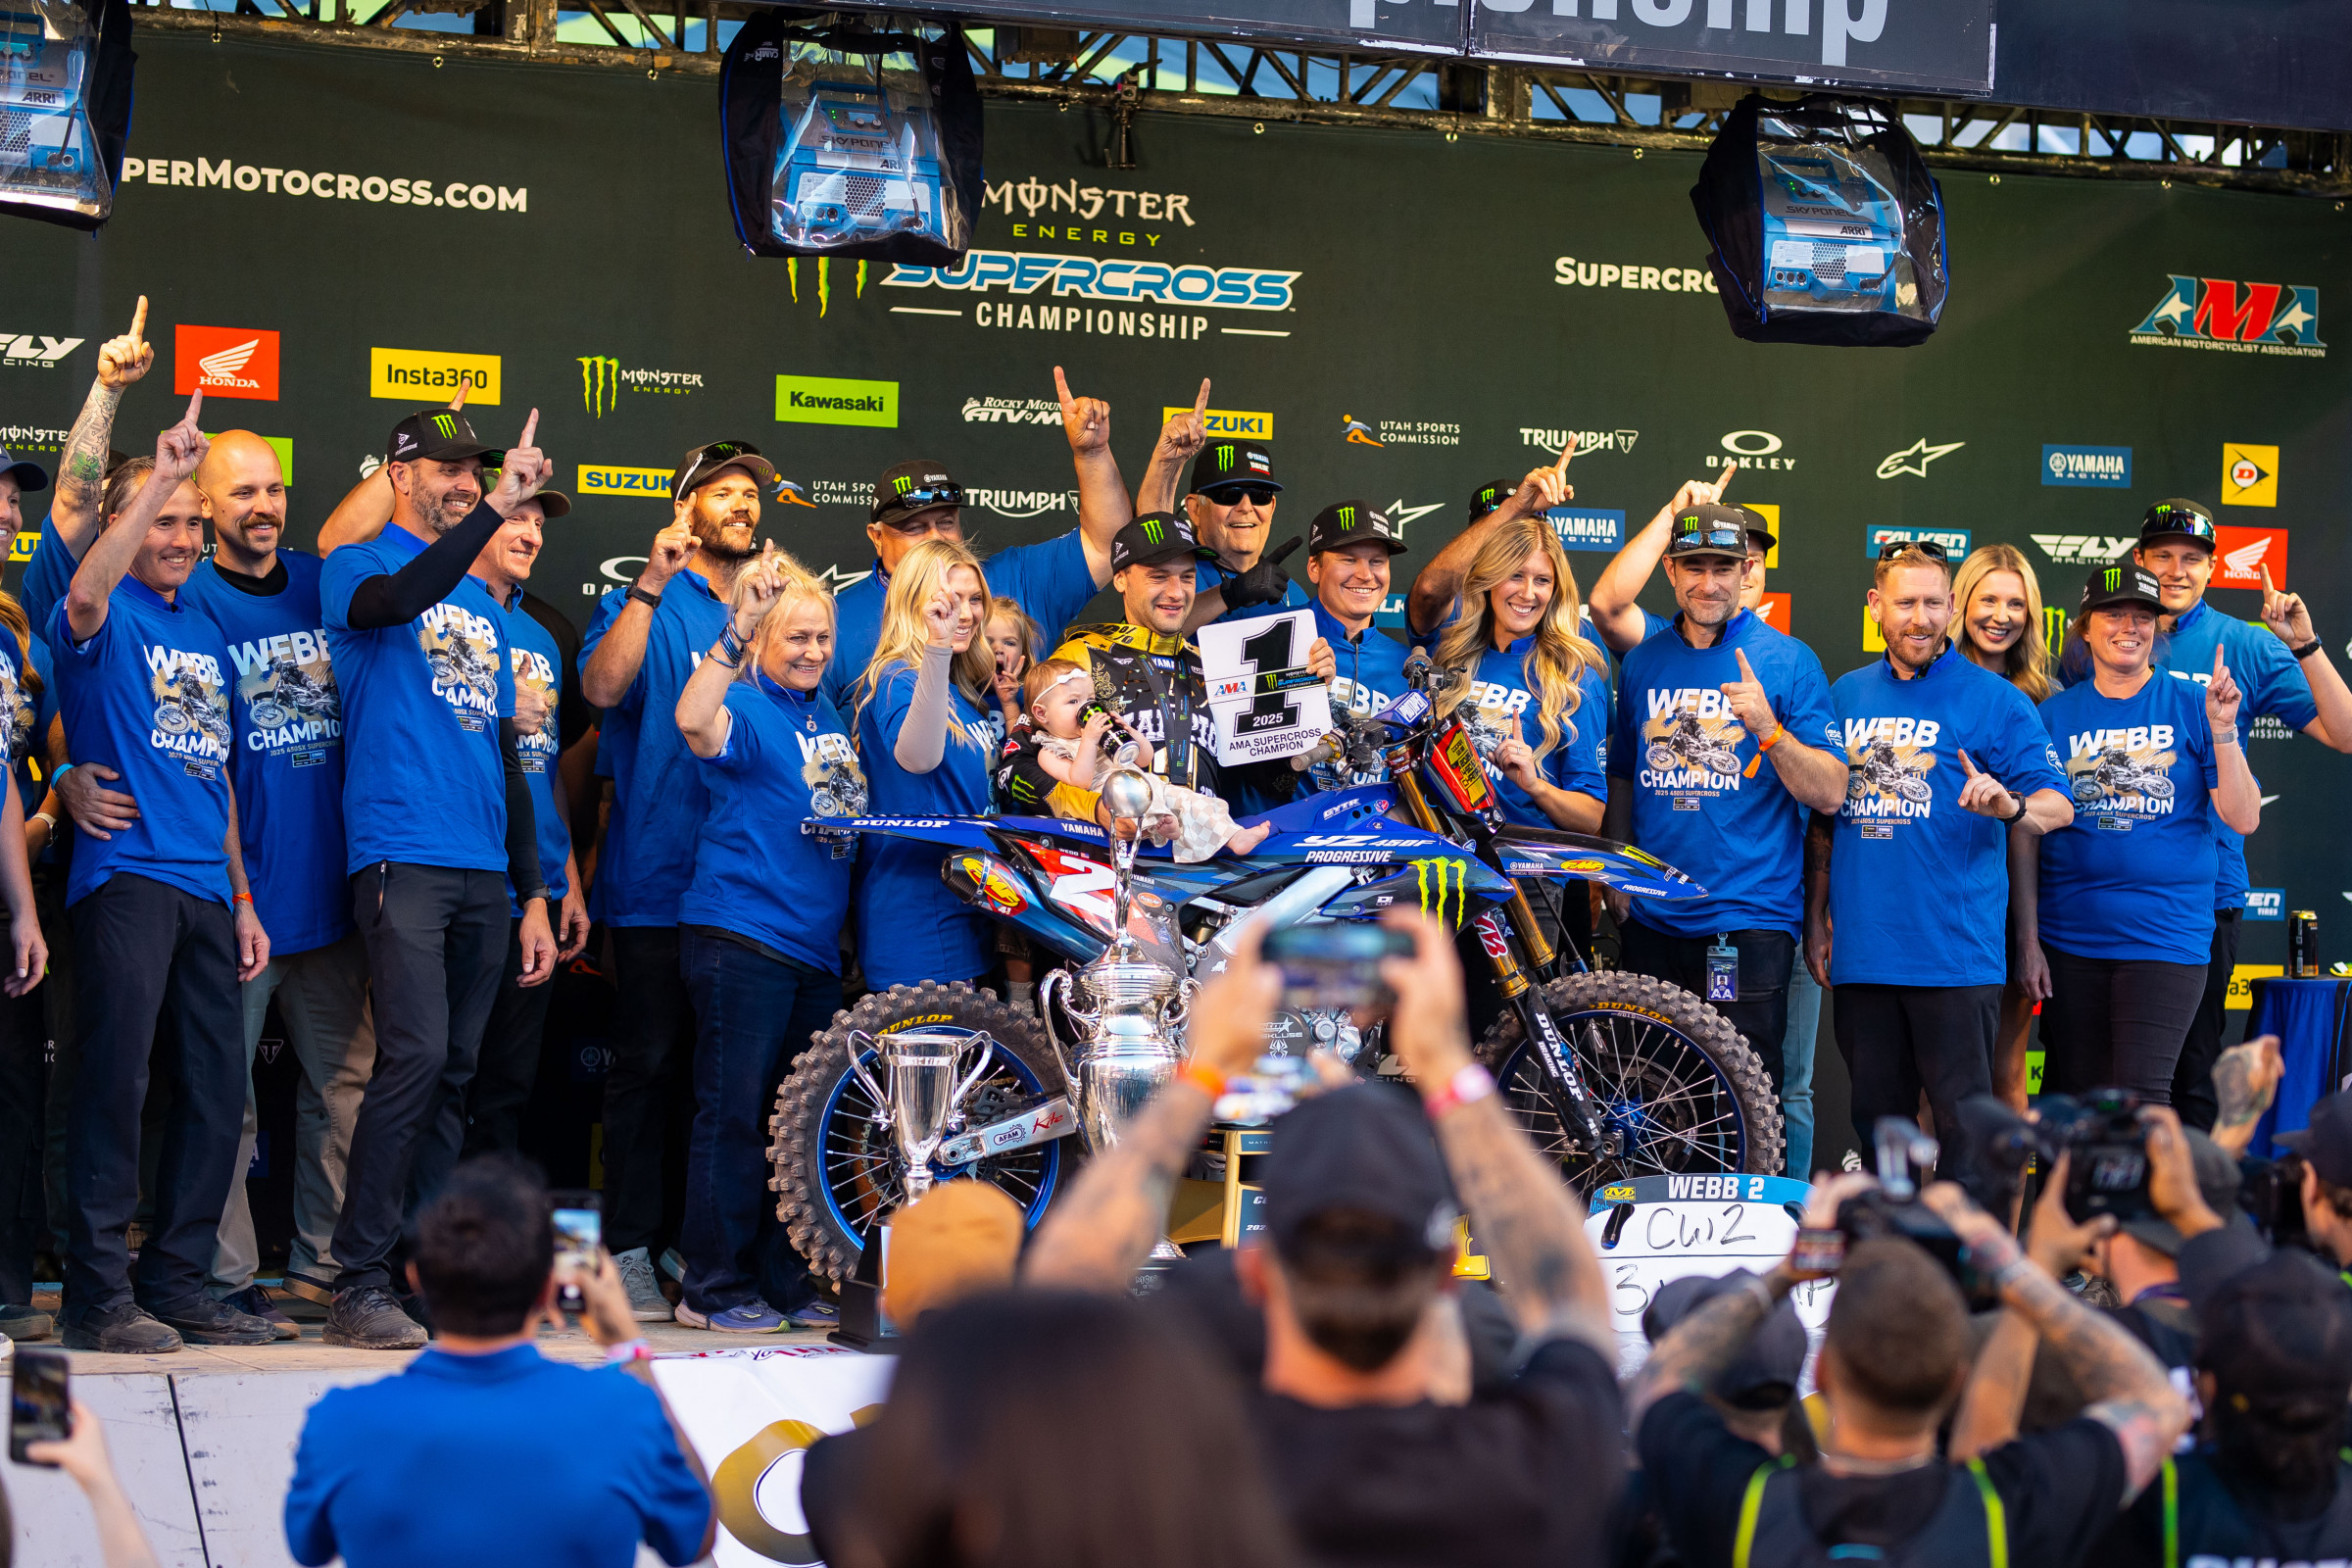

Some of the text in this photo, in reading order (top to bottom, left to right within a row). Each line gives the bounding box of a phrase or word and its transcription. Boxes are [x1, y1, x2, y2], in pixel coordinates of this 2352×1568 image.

[23, 91, 56, 104] ARRI
[982, 176, 1196, 226] MONSTER
[1012, 223, 1161, 247] ENERGY
[1840, 225, 1866, 236] ARRI
[880, 249, 1303, 312] SUPERCROSS
[976, 302, 1209, 340] CHAMPIONSHIP
[2129, 273, 2328, 348] AMA
[2131, 334, 2326, 358] AMERICAN MOTORCYCLIST ASSOCIATION
[199, 375, 260, 388] HONDA
[387, 363, 488, 389] Insta360
[620, 368, 704, 389] MONSTER
[633, 385, 692, 395] ENERGY
[790, 390, 884, 413] Kawasaki
[983, 396, 1024, 410] ROCKY
[1380, 420, 1460, 433] UTAH SPORTS
[1380, 432, 1460, 446] COMMISSION
[1520, 427, 1614, 455] TRIUMPH
[1706, 455, 1795, 471] OAKLEY
[2065, 453, 2125, 474] YAMAHA
[812, 480, 847, 492] UTAH
[2055, 471, 2121, 480] RACING
[965, 488, 1066, 515] TRIUMPH
[1555, 515, 1617, 538] YAMAHA
[2052, 557, 2115, 565] RACING
[143, 644, 225, 687] WEBB
[1214, 681, 1248, 696] AMA
[1252, 712, 1284, 727] 2025
[1229, 728, 1322, 752] AMA SUPERCROSS
[1844, 717, 1940, 747] WEBB
[2069, 724, 2175, 758] WEBB
[1250, 740, 1304, 757] CHAMPION
[1323, 798, 1361, 820] GYTR
[2115, 810, 2156, 821] SUPERCROSS
[852, 818, 951, 829] DUNLOP
[1061, 822, 1104, 838] YAMAHA
[1304, 850, 1394, 863] PROGRESSIVE
[1622, 884, 1668, 897] PROGRESSIVE
[1710, 988, 1734, 1000] AA
[1596, 1001, 1674, 1026] DUNLOP
[877, 1013, 954, 1036] DUNLOP
[1535, 1012, 1585, 1102] DUNLOP
[1536, 1041, 1560, 1078] BRAKING
[998, 1110, 1064, 1143] AFAM Kite
[1668, 1176, 1765, 1200] WEBB 2
